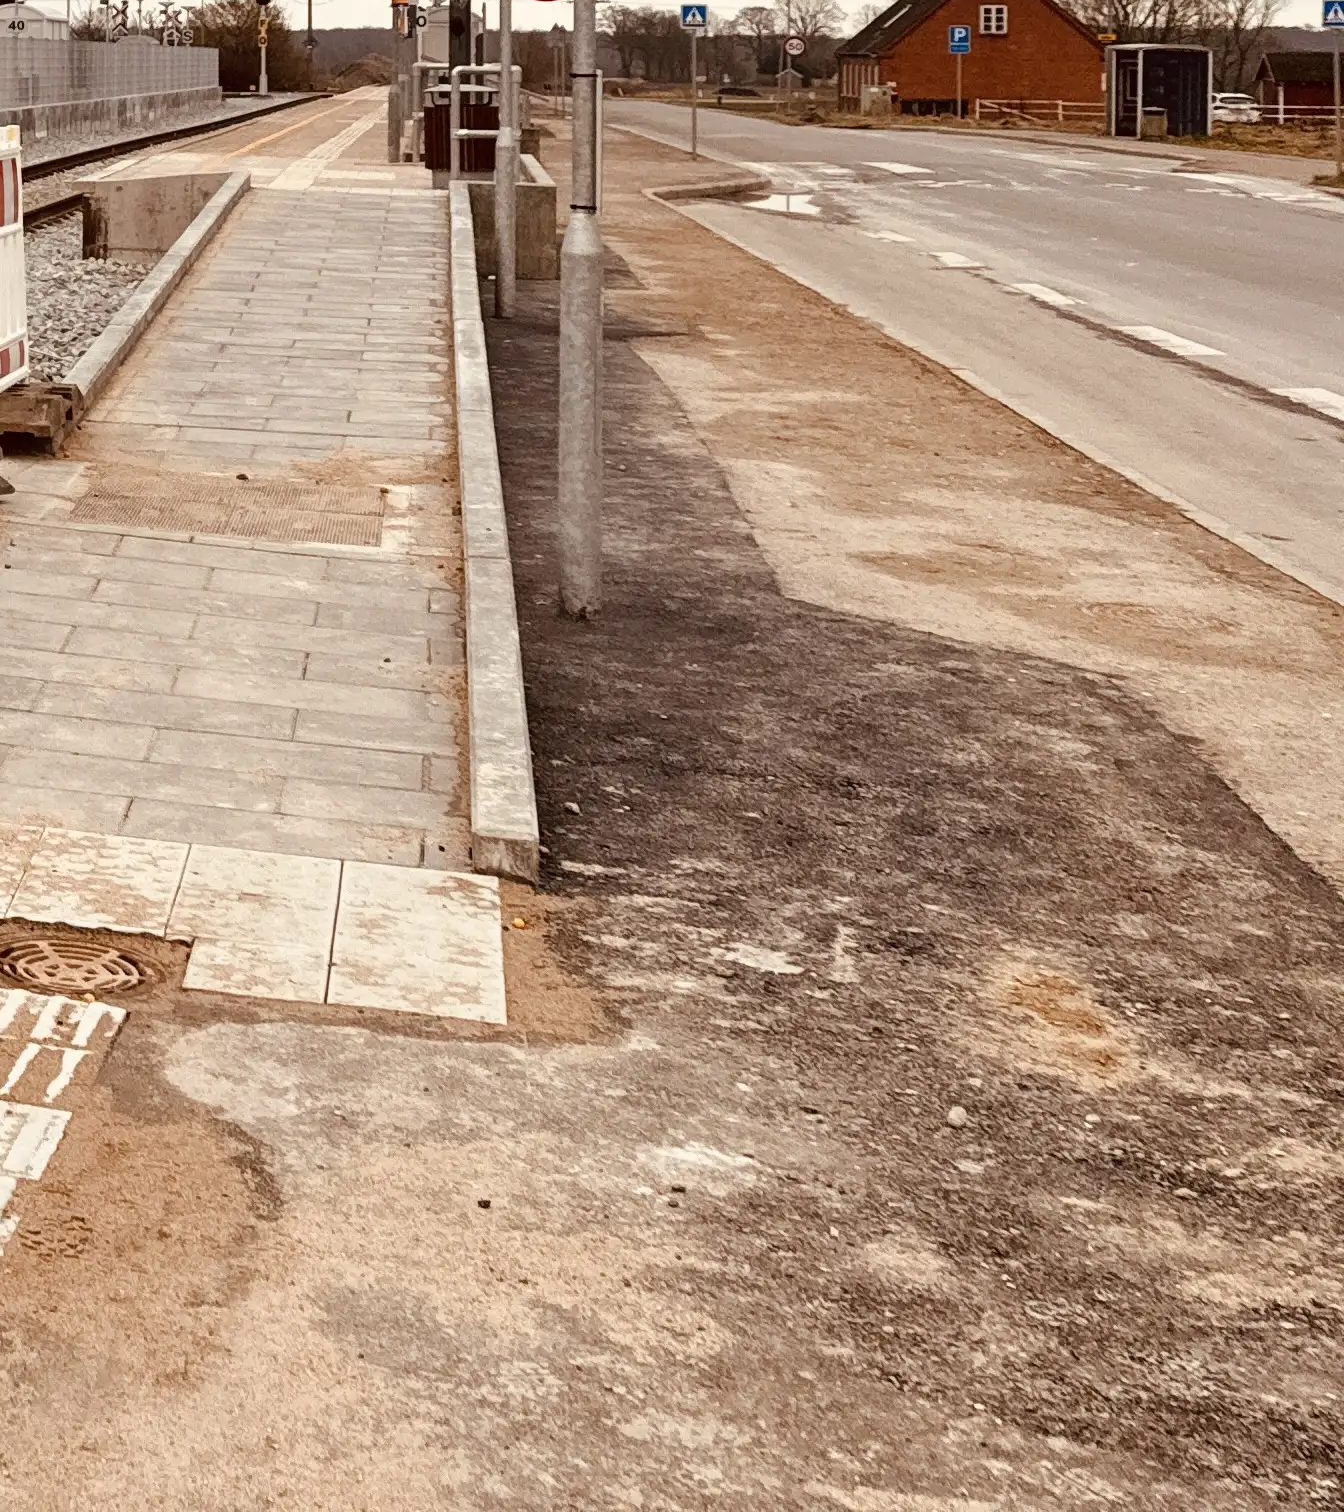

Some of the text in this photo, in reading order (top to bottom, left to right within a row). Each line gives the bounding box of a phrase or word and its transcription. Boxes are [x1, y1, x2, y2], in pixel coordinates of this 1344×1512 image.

[8, 20, 25, 31] 40
[183, 30, 193, 41] S
[954, 28, 967, 42] P
[788, 42, 802, 51] 50
